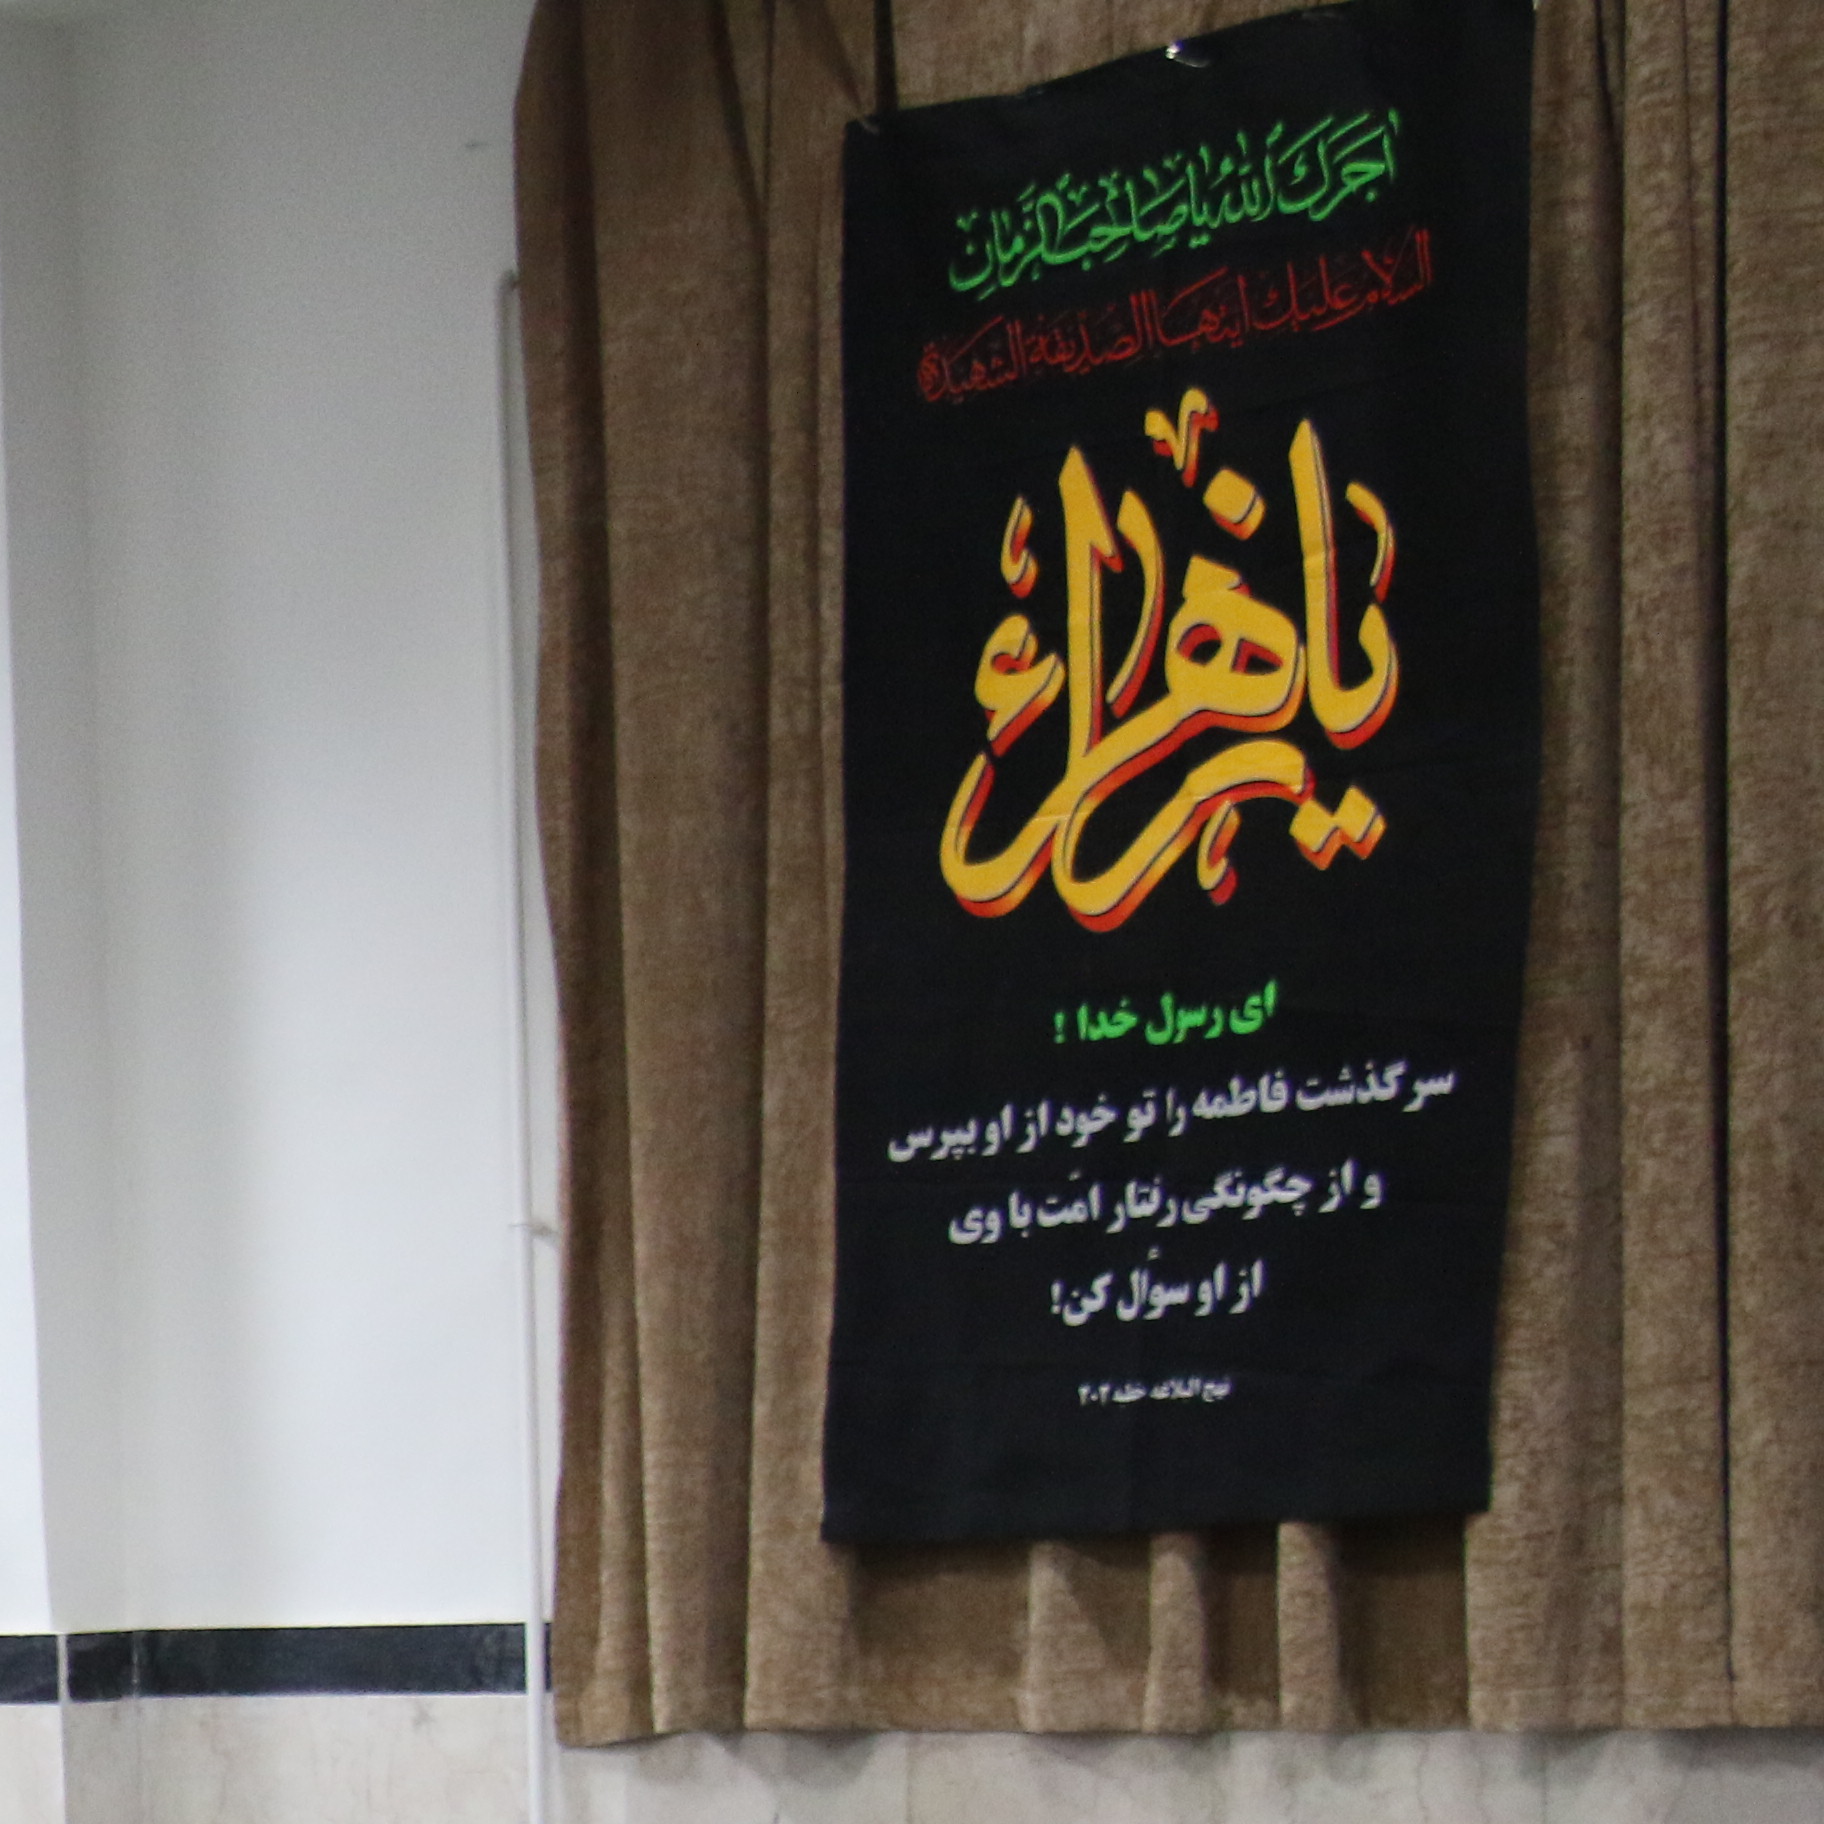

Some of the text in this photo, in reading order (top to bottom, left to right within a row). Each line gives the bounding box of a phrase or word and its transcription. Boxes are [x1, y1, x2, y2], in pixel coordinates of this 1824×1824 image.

[1077, 997, 1138, 1042] خدا
[1145, 992, 1223, 1046] رسول
[1229, 978, 1277, 1035] ای
[1054, 1093, 1118, 1148] خود
[1123, 1088, 1157, 1143] تو
[1166, 1088, 1187, 1138] را
[1193, 1068, 1289, 1121] فاطمه
[887, 1118, 977, 1162] بپرس
[982, 1104, 1013, 1157] او
[1017, 1100, 1050, 1154] از
[1106, 1175, 1177, 1235] رفتار
[1181, 1167, 1313, 1225] چگونگی
[1319, 1157, 1355, 1214] از
[1360, 1171, 1383, 1209] و
[948, 1204, 1002, 1244] وی
[1009, 1192, 1033, 1238] با
[1195, 1262, 1226, 1316] او
[1229, 1258, 1263, 1314] از
